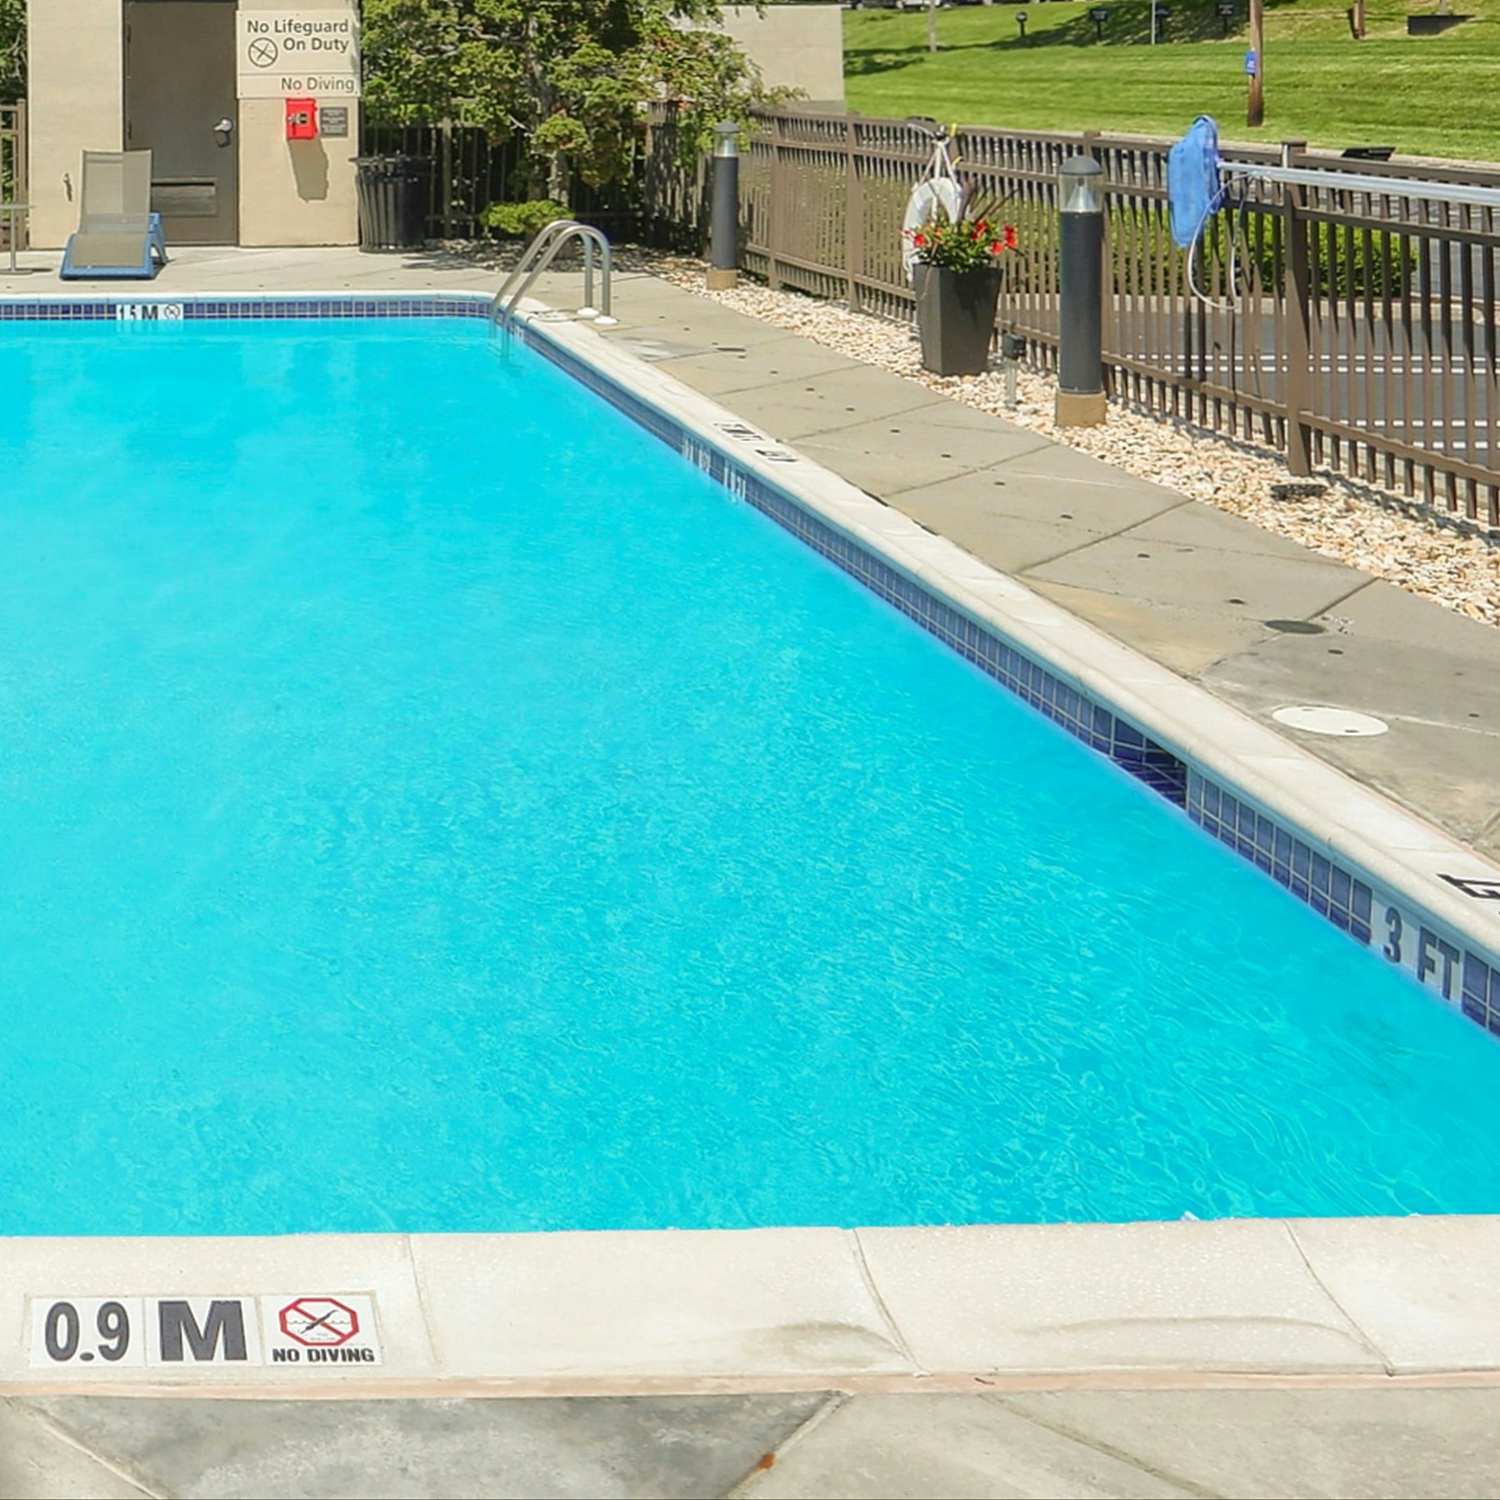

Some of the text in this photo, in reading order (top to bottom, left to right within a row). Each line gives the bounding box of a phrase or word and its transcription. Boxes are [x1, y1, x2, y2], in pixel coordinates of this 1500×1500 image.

[247, 19, 348, 36] No Lifeguard
[283, 37, 349, 54] On Duty
[281, 77, 355, 92] No Diving
[142, 304, 158, 320] M
[1383, 906, 1460, 1001] 3 FT
[44, 1300, 248, 1362] 0.9 M
[272, 1348, 375, 1363] NO DIVING
